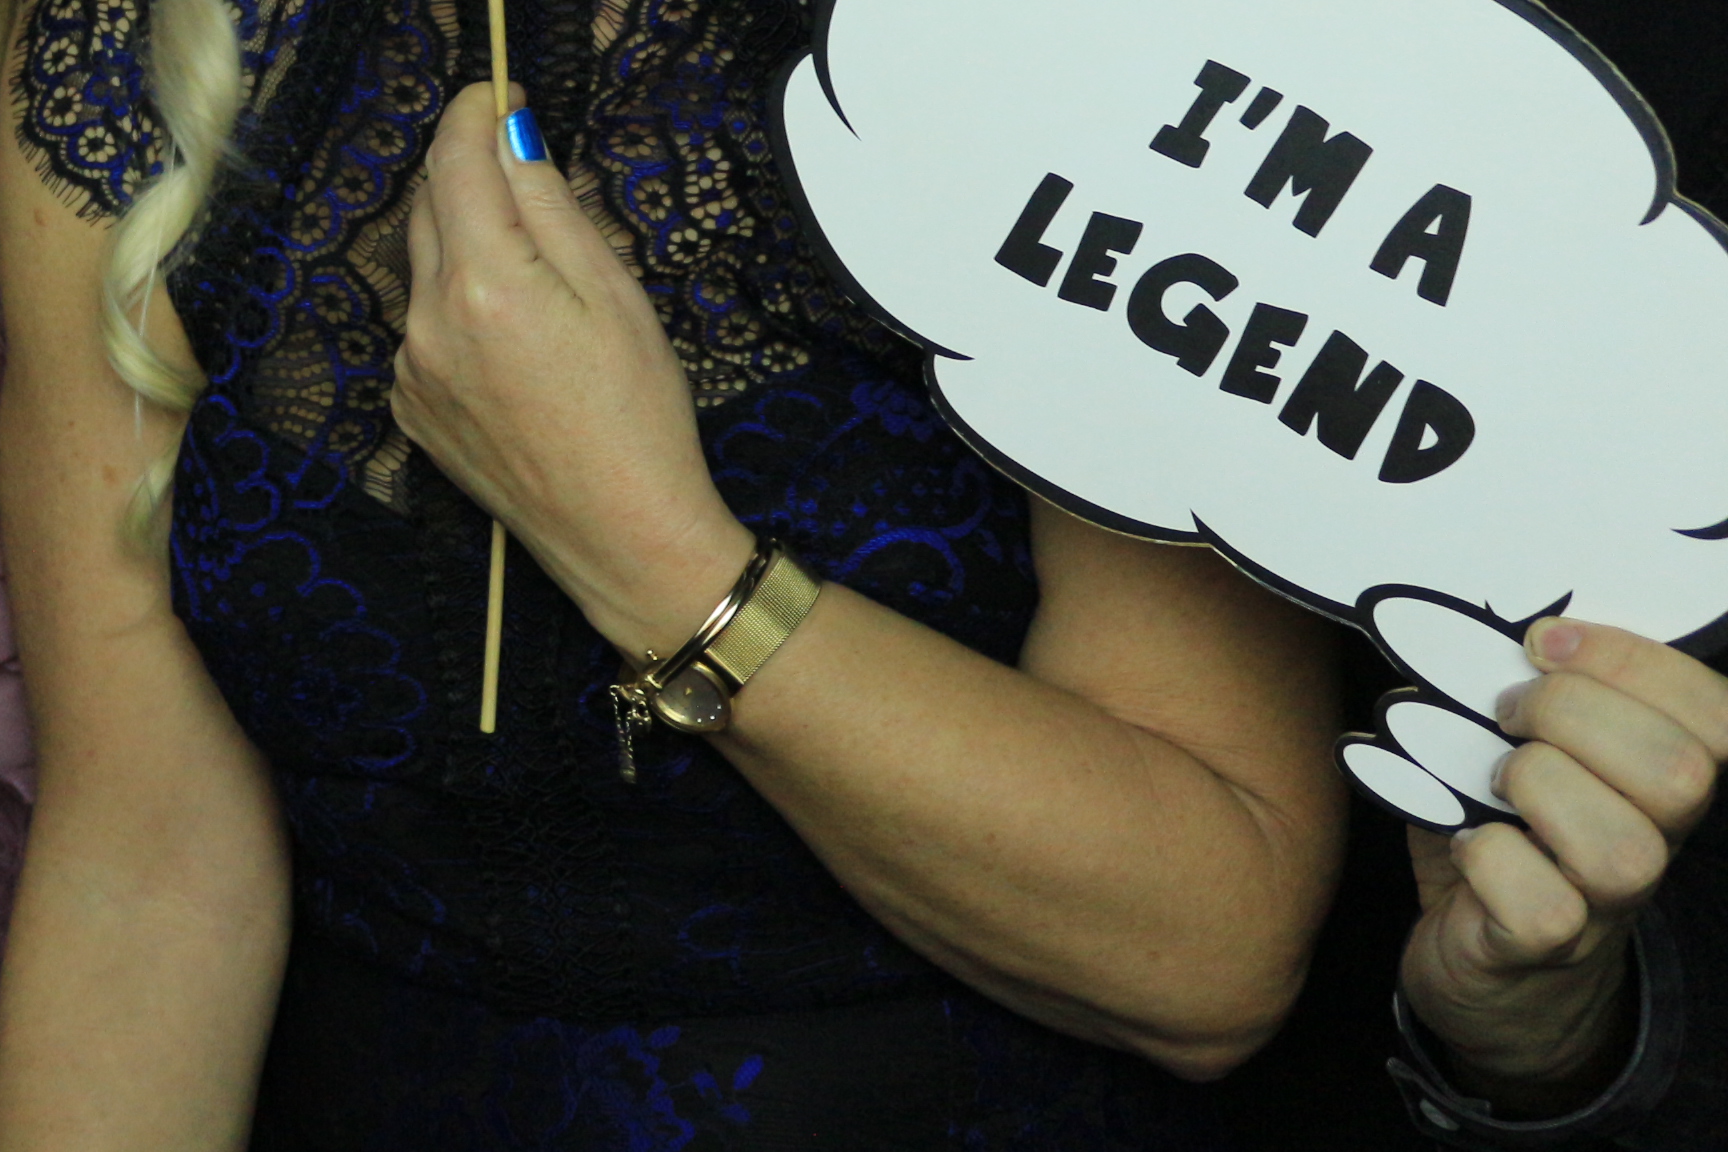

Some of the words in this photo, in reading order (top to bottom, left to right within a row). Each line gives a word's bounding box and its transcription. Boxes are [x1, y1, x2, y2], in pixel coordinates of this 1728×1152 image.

[1148, 58, 1374, 239] I'M
[1368, 182, 1473, 308] A
[993, 171, 1476, 485] LEGEND
